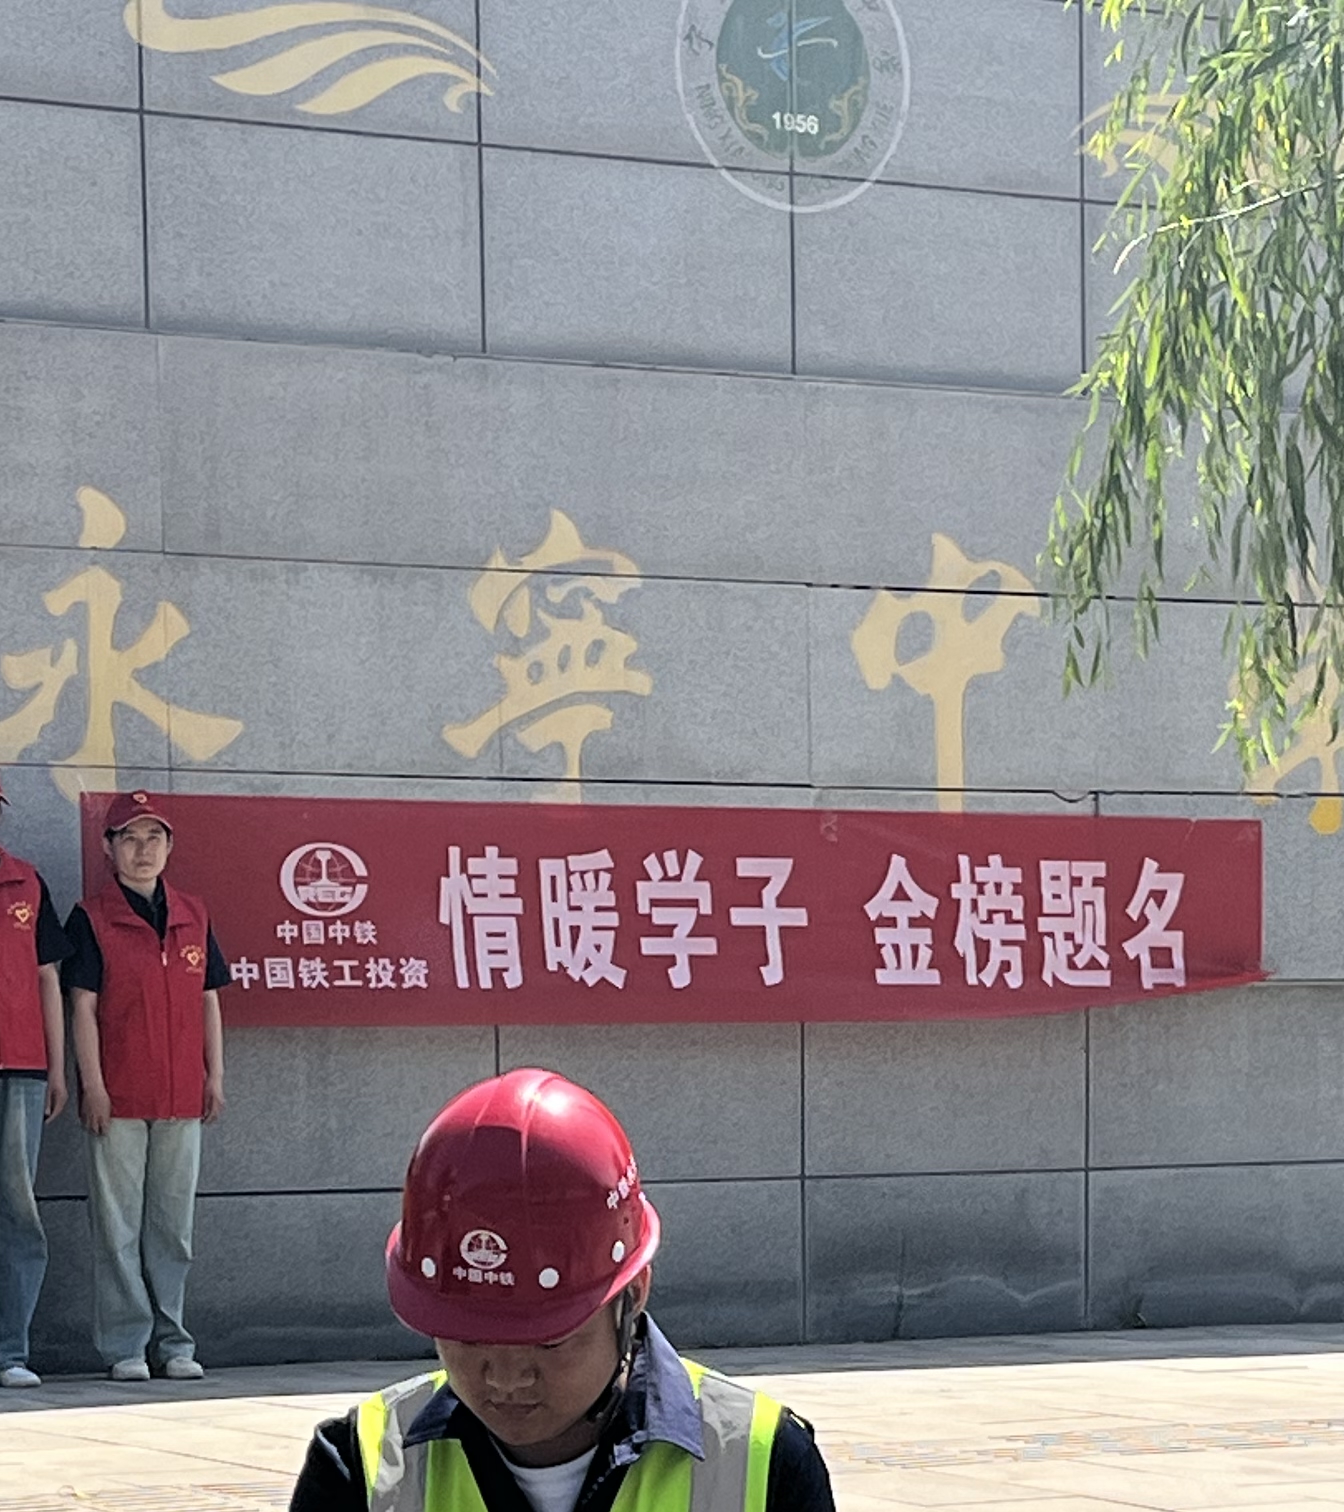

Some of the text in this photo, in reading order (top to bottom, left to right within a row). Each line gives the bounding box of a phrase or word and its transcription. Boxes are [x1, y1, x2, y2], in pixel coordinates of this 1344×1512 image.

[772, 112, 819, 134] 1956
[439, 846, 1186, 989] 情暖学子 金榜题名
[276, 920, 378, 945] 中国中铁
[230, 956, 429, 989] 中国铁工投资
